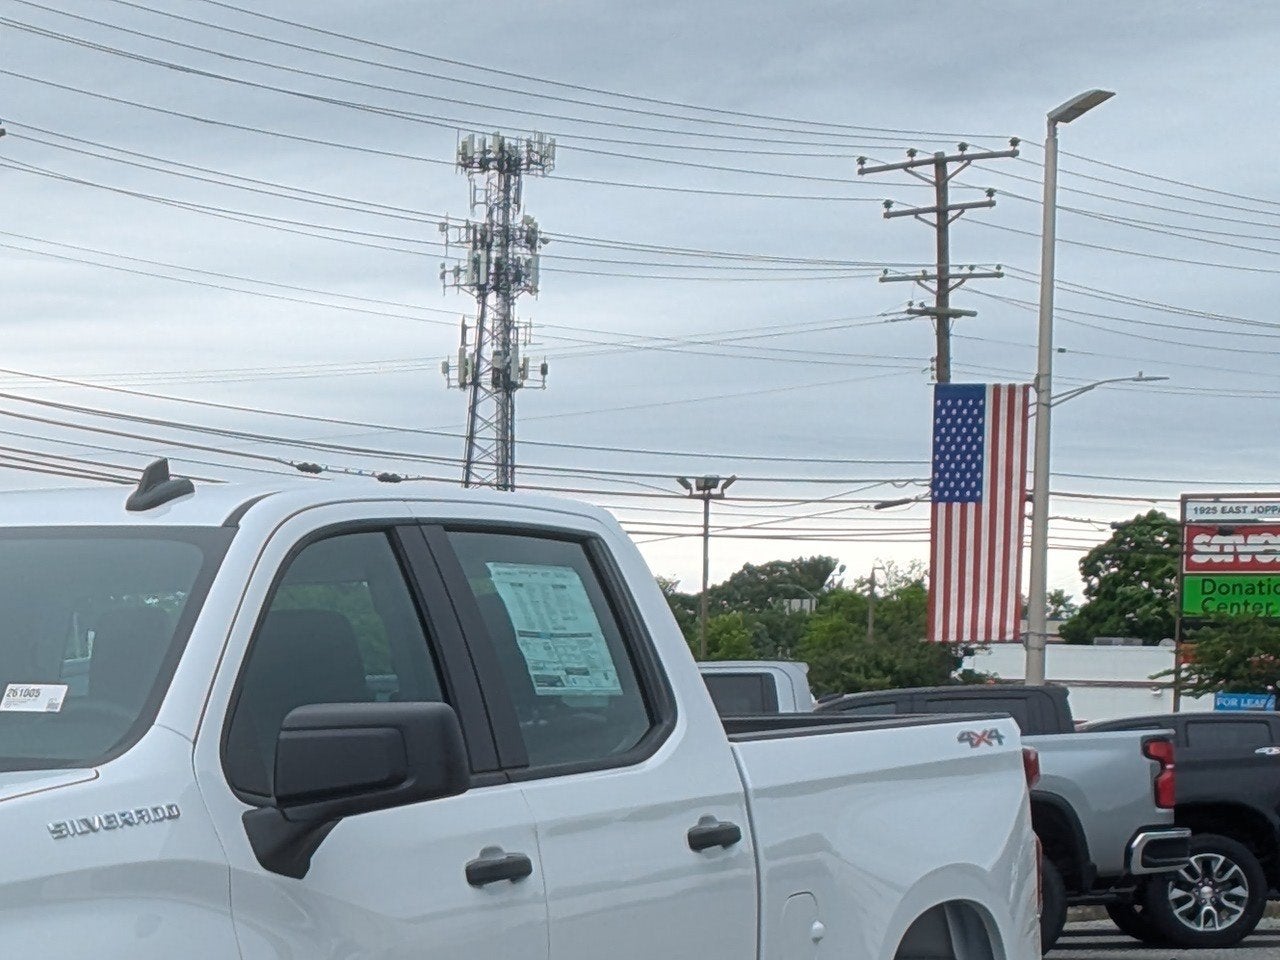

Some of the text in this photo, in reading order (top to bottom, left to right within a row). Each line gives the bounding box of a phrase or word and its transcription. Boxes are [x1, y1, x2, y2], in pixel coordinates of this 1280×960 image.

[1193, 505, 1280, 515] 1925 EAST JOPP
[1201, 596, 1274, 616] Center
[1216, 697, 1238, 708] FOR
[46, 803, 181, 840] SILVERADO
